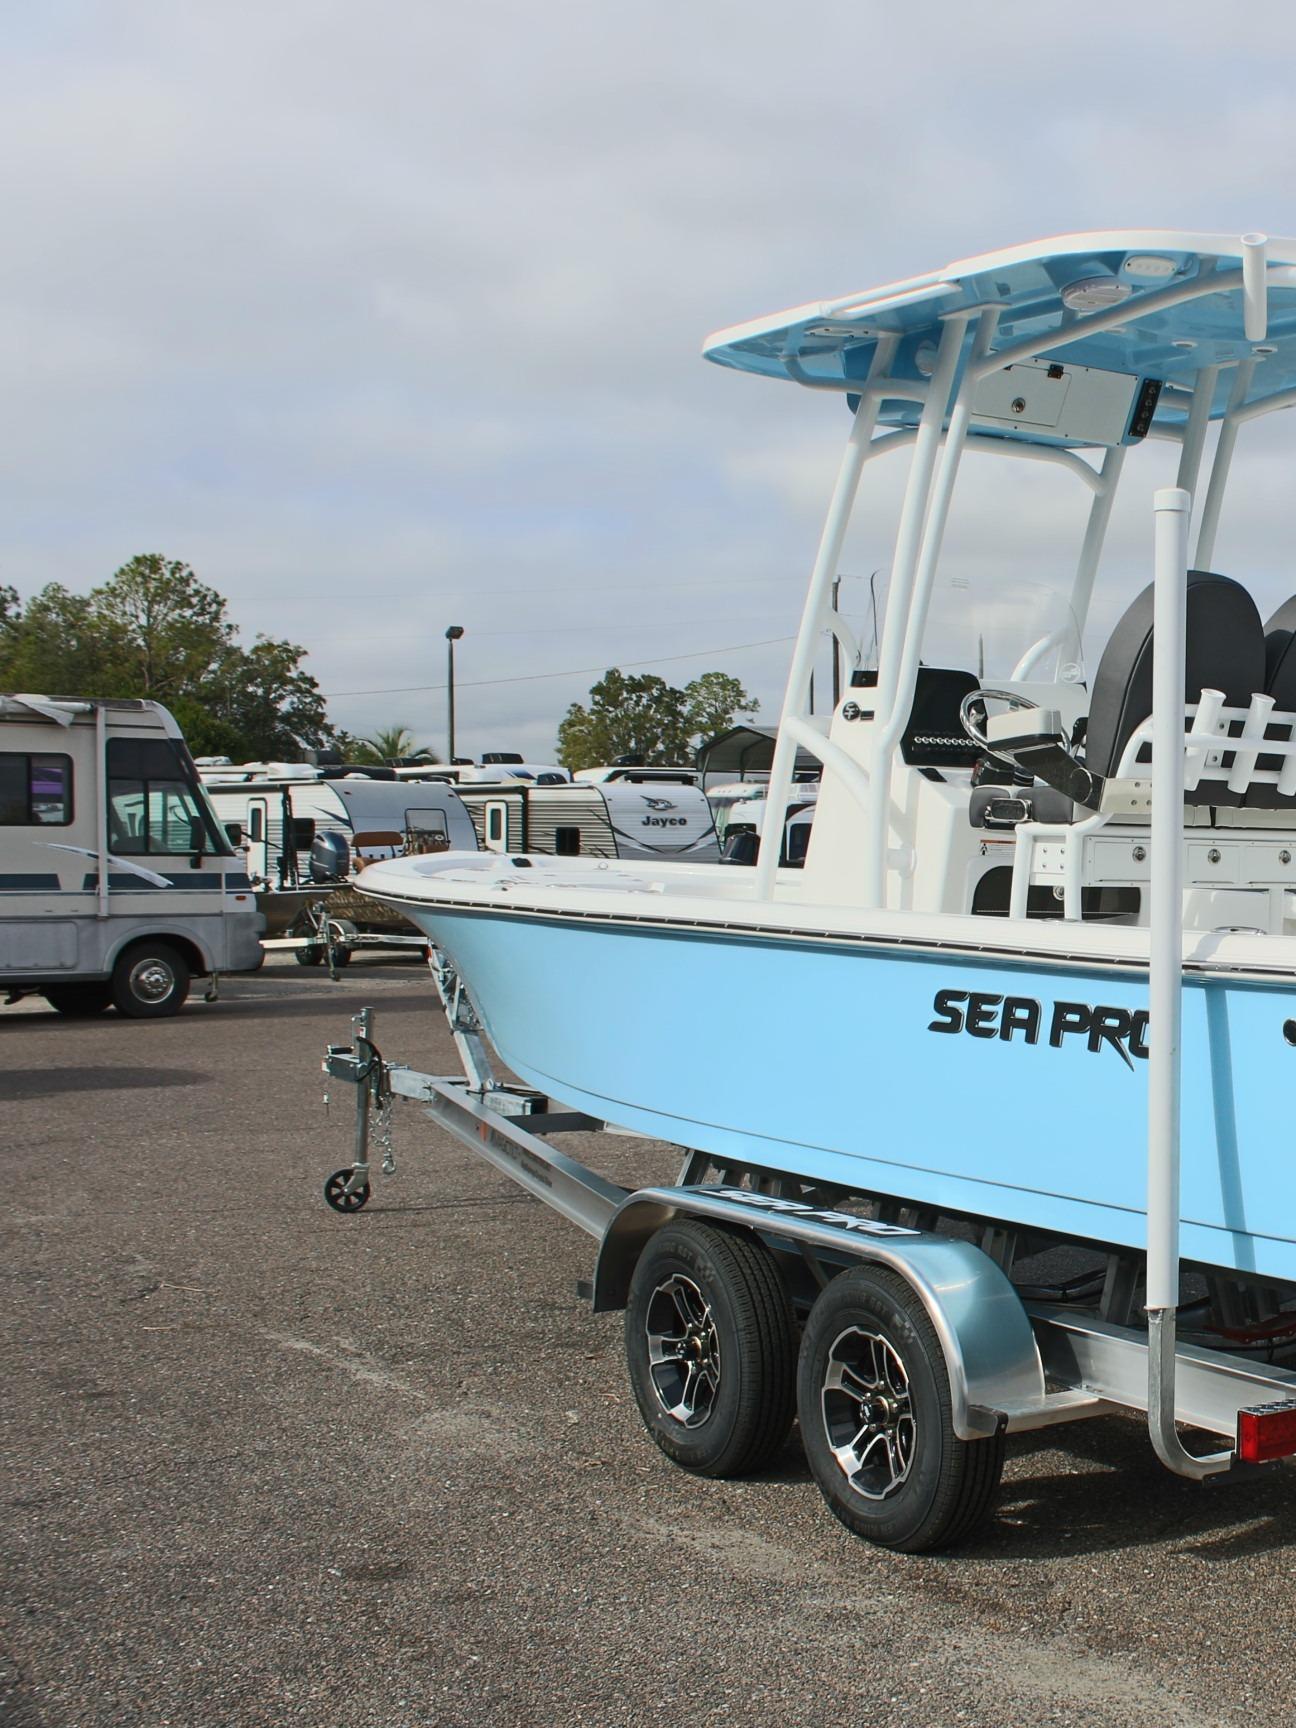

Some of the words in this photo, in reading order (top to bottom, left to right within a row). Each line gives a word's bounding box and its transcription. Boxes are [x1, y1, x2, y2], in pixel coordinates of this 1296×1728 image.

[641, 815, 688, 828] Jayco
[928, 989, 1042, 1045] SEA
[699, 1190, 814, 1210] SEA
[793, 1211, 921, 1235] PRO
